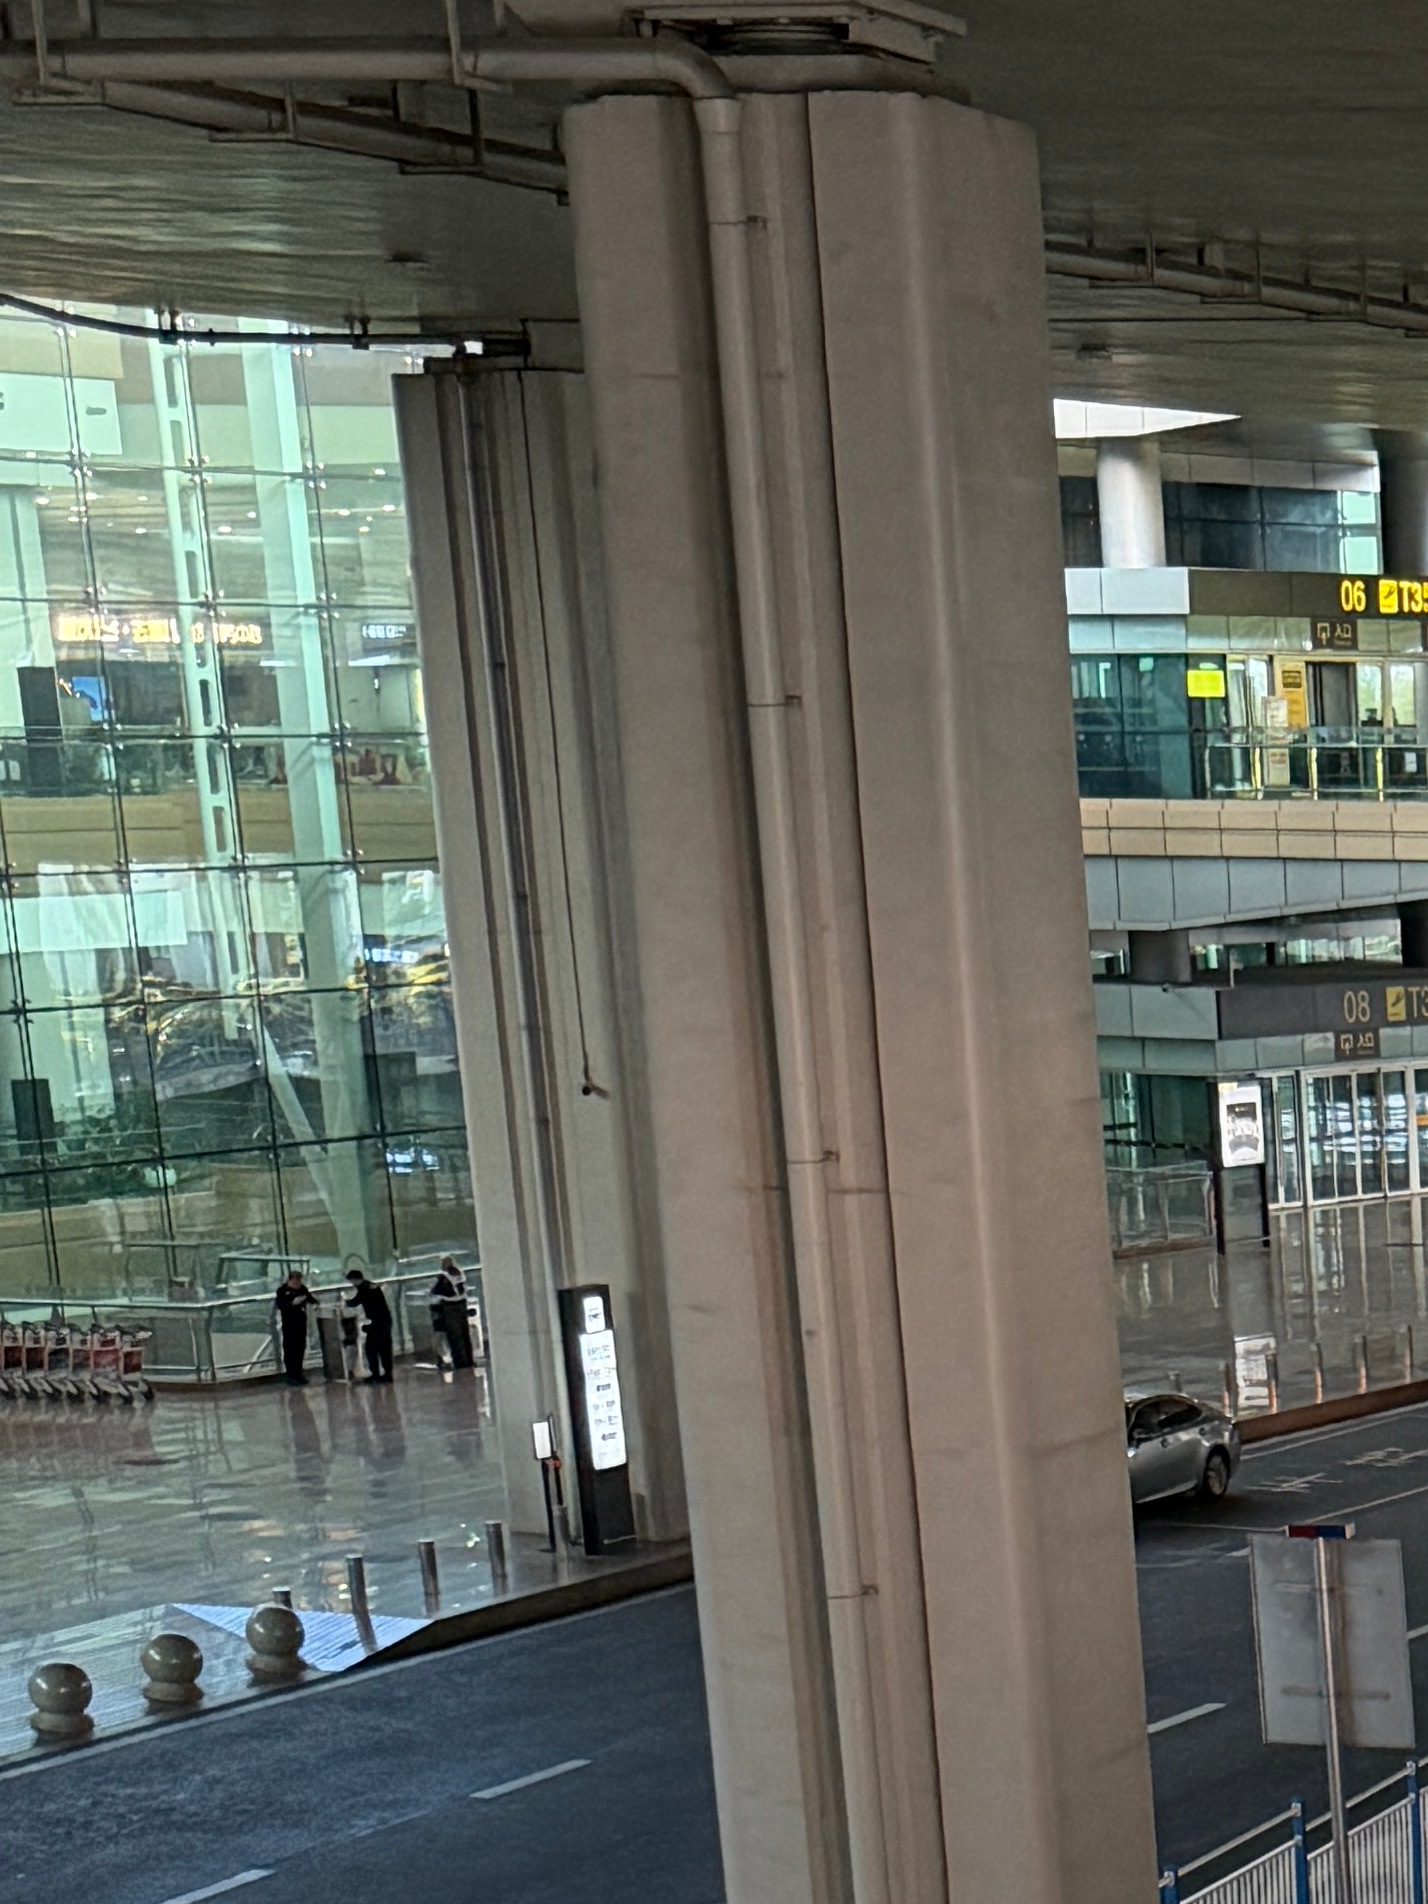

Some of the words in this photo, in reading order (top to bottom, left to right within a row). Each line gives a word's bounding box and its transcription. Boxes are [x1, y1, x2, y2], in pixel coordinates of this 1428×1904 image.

[1341, 580, 1366, 612] 06
[1399, 580, 1423, 612] T3
[1343, 990, 1371, 1023] 08
